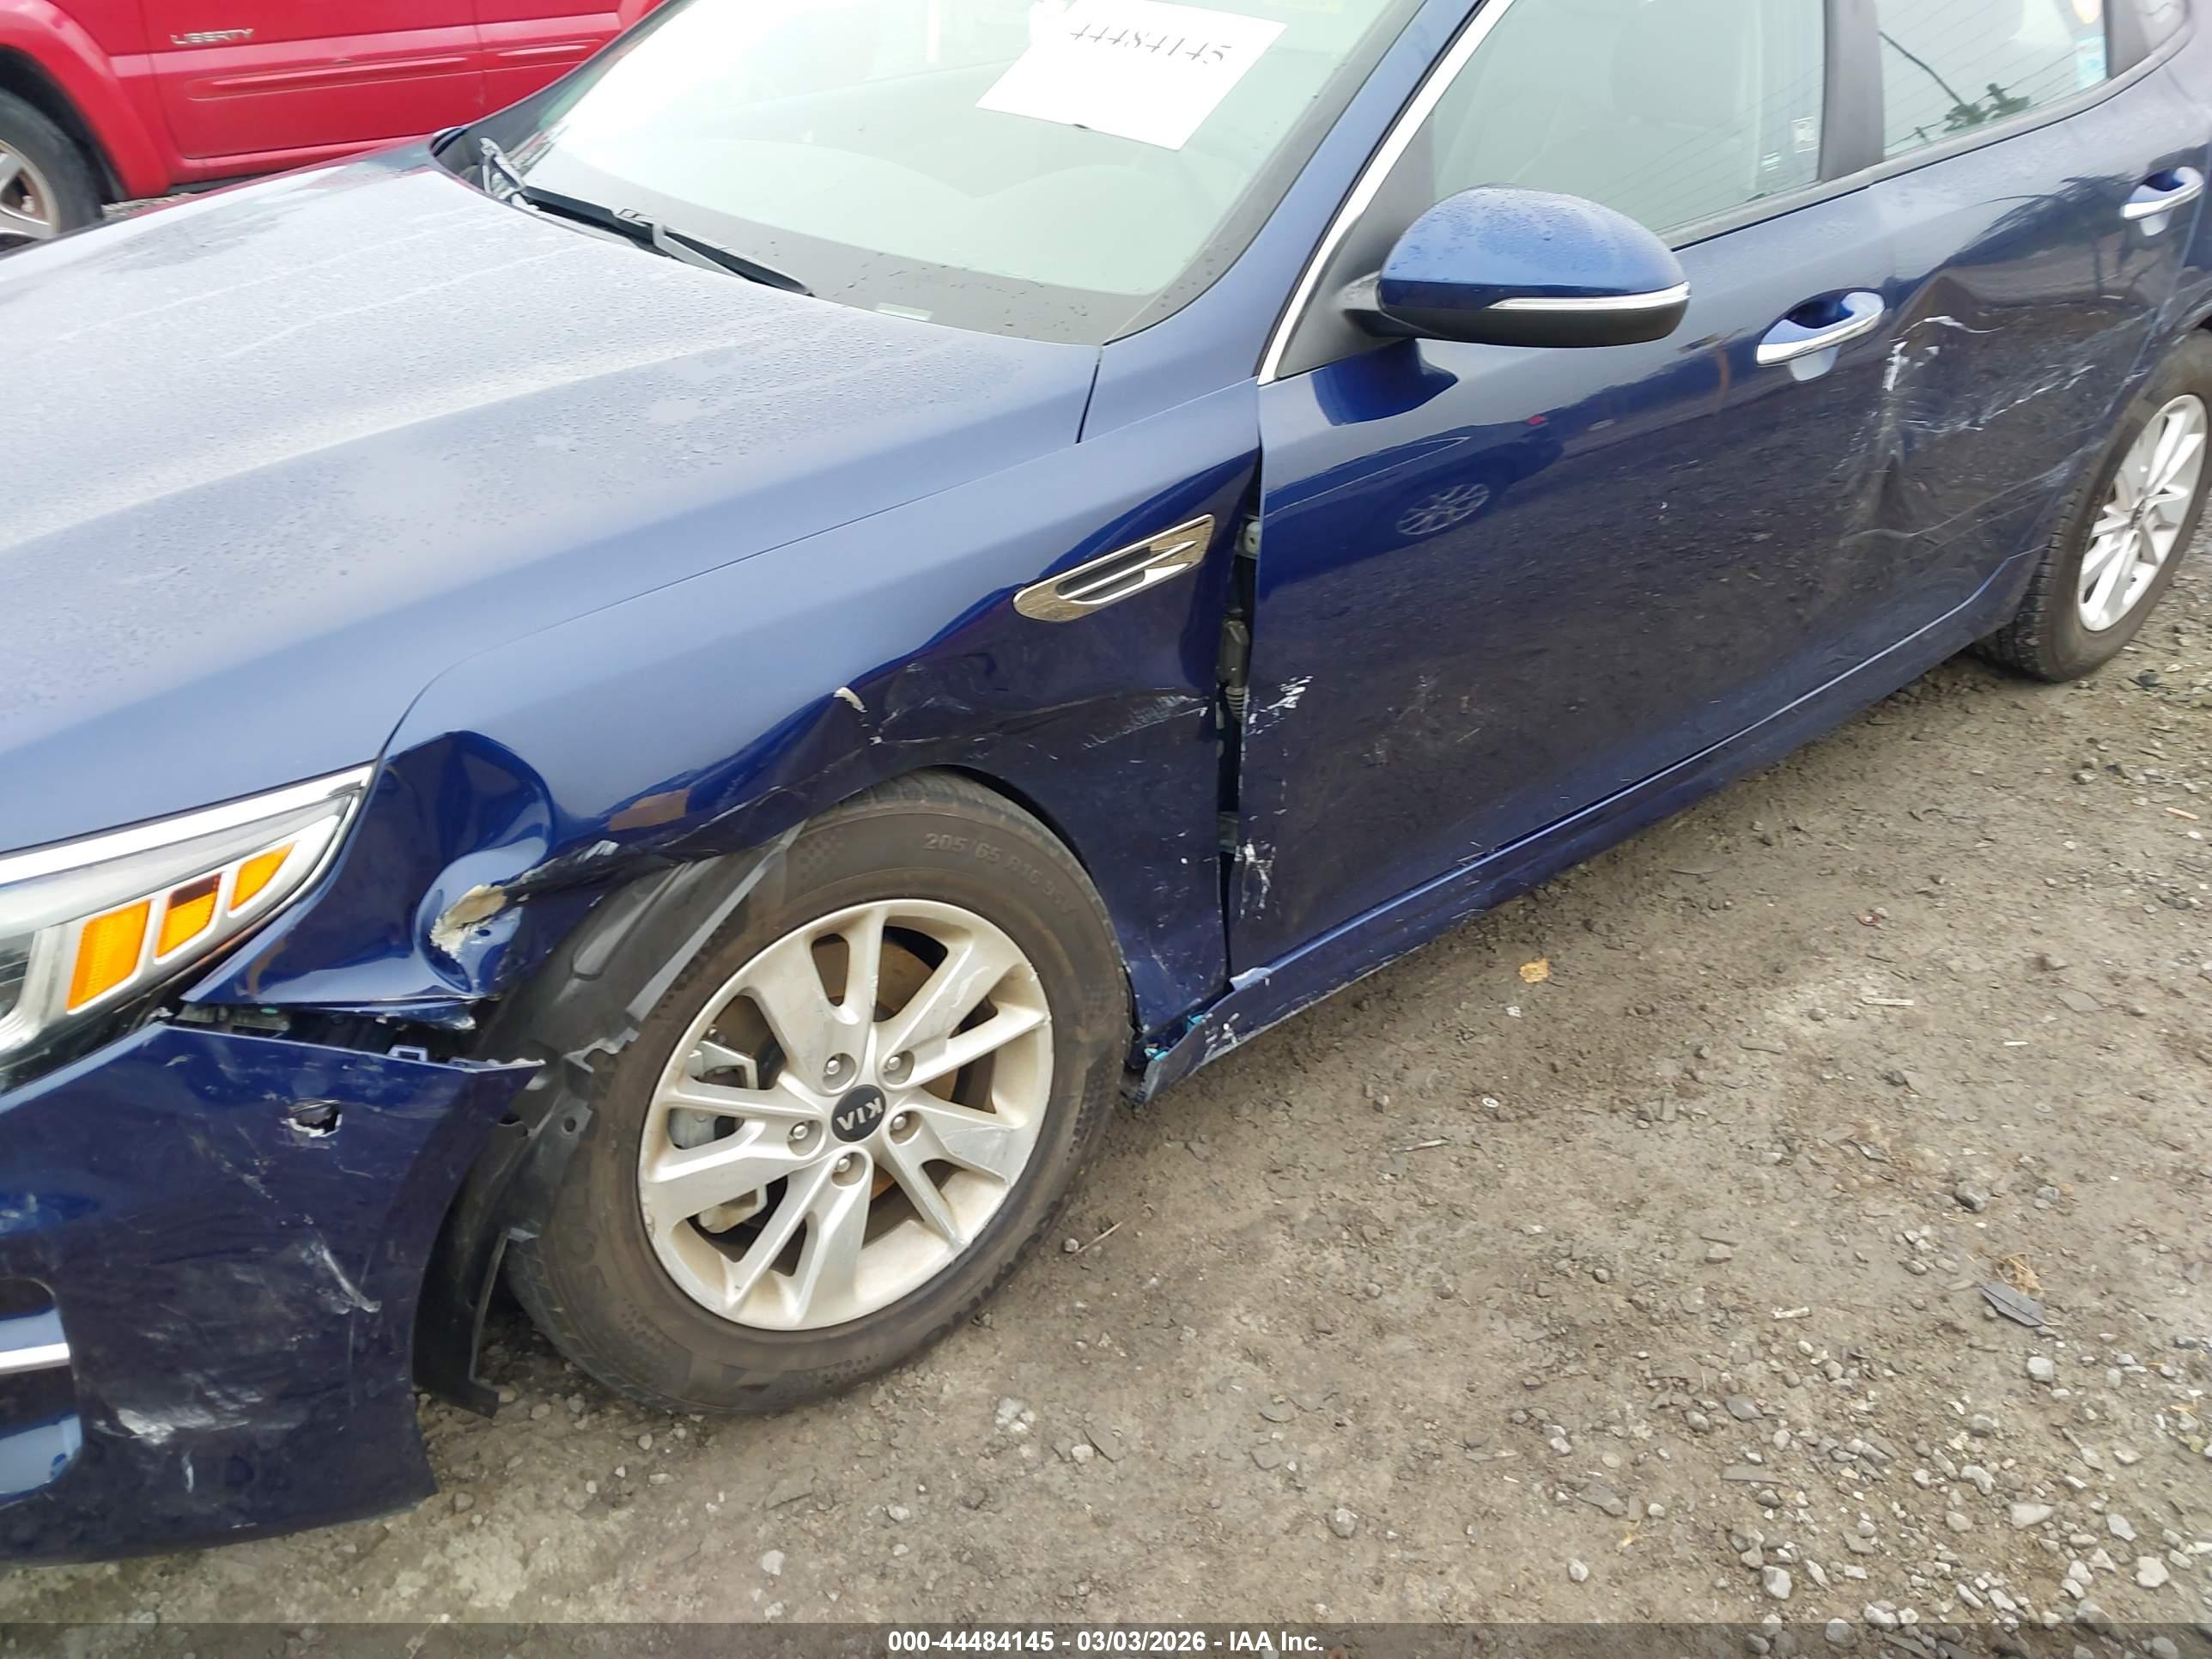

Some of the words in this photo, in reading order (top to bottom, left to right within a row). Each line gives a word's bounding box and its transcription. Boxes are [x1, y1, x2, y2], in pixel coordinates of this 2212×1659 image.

[170, 27, 255, 46] LIBERTY
[1069, 23, 1232, 64] 44484145
[836, 1097, 884, 1131] KIA
